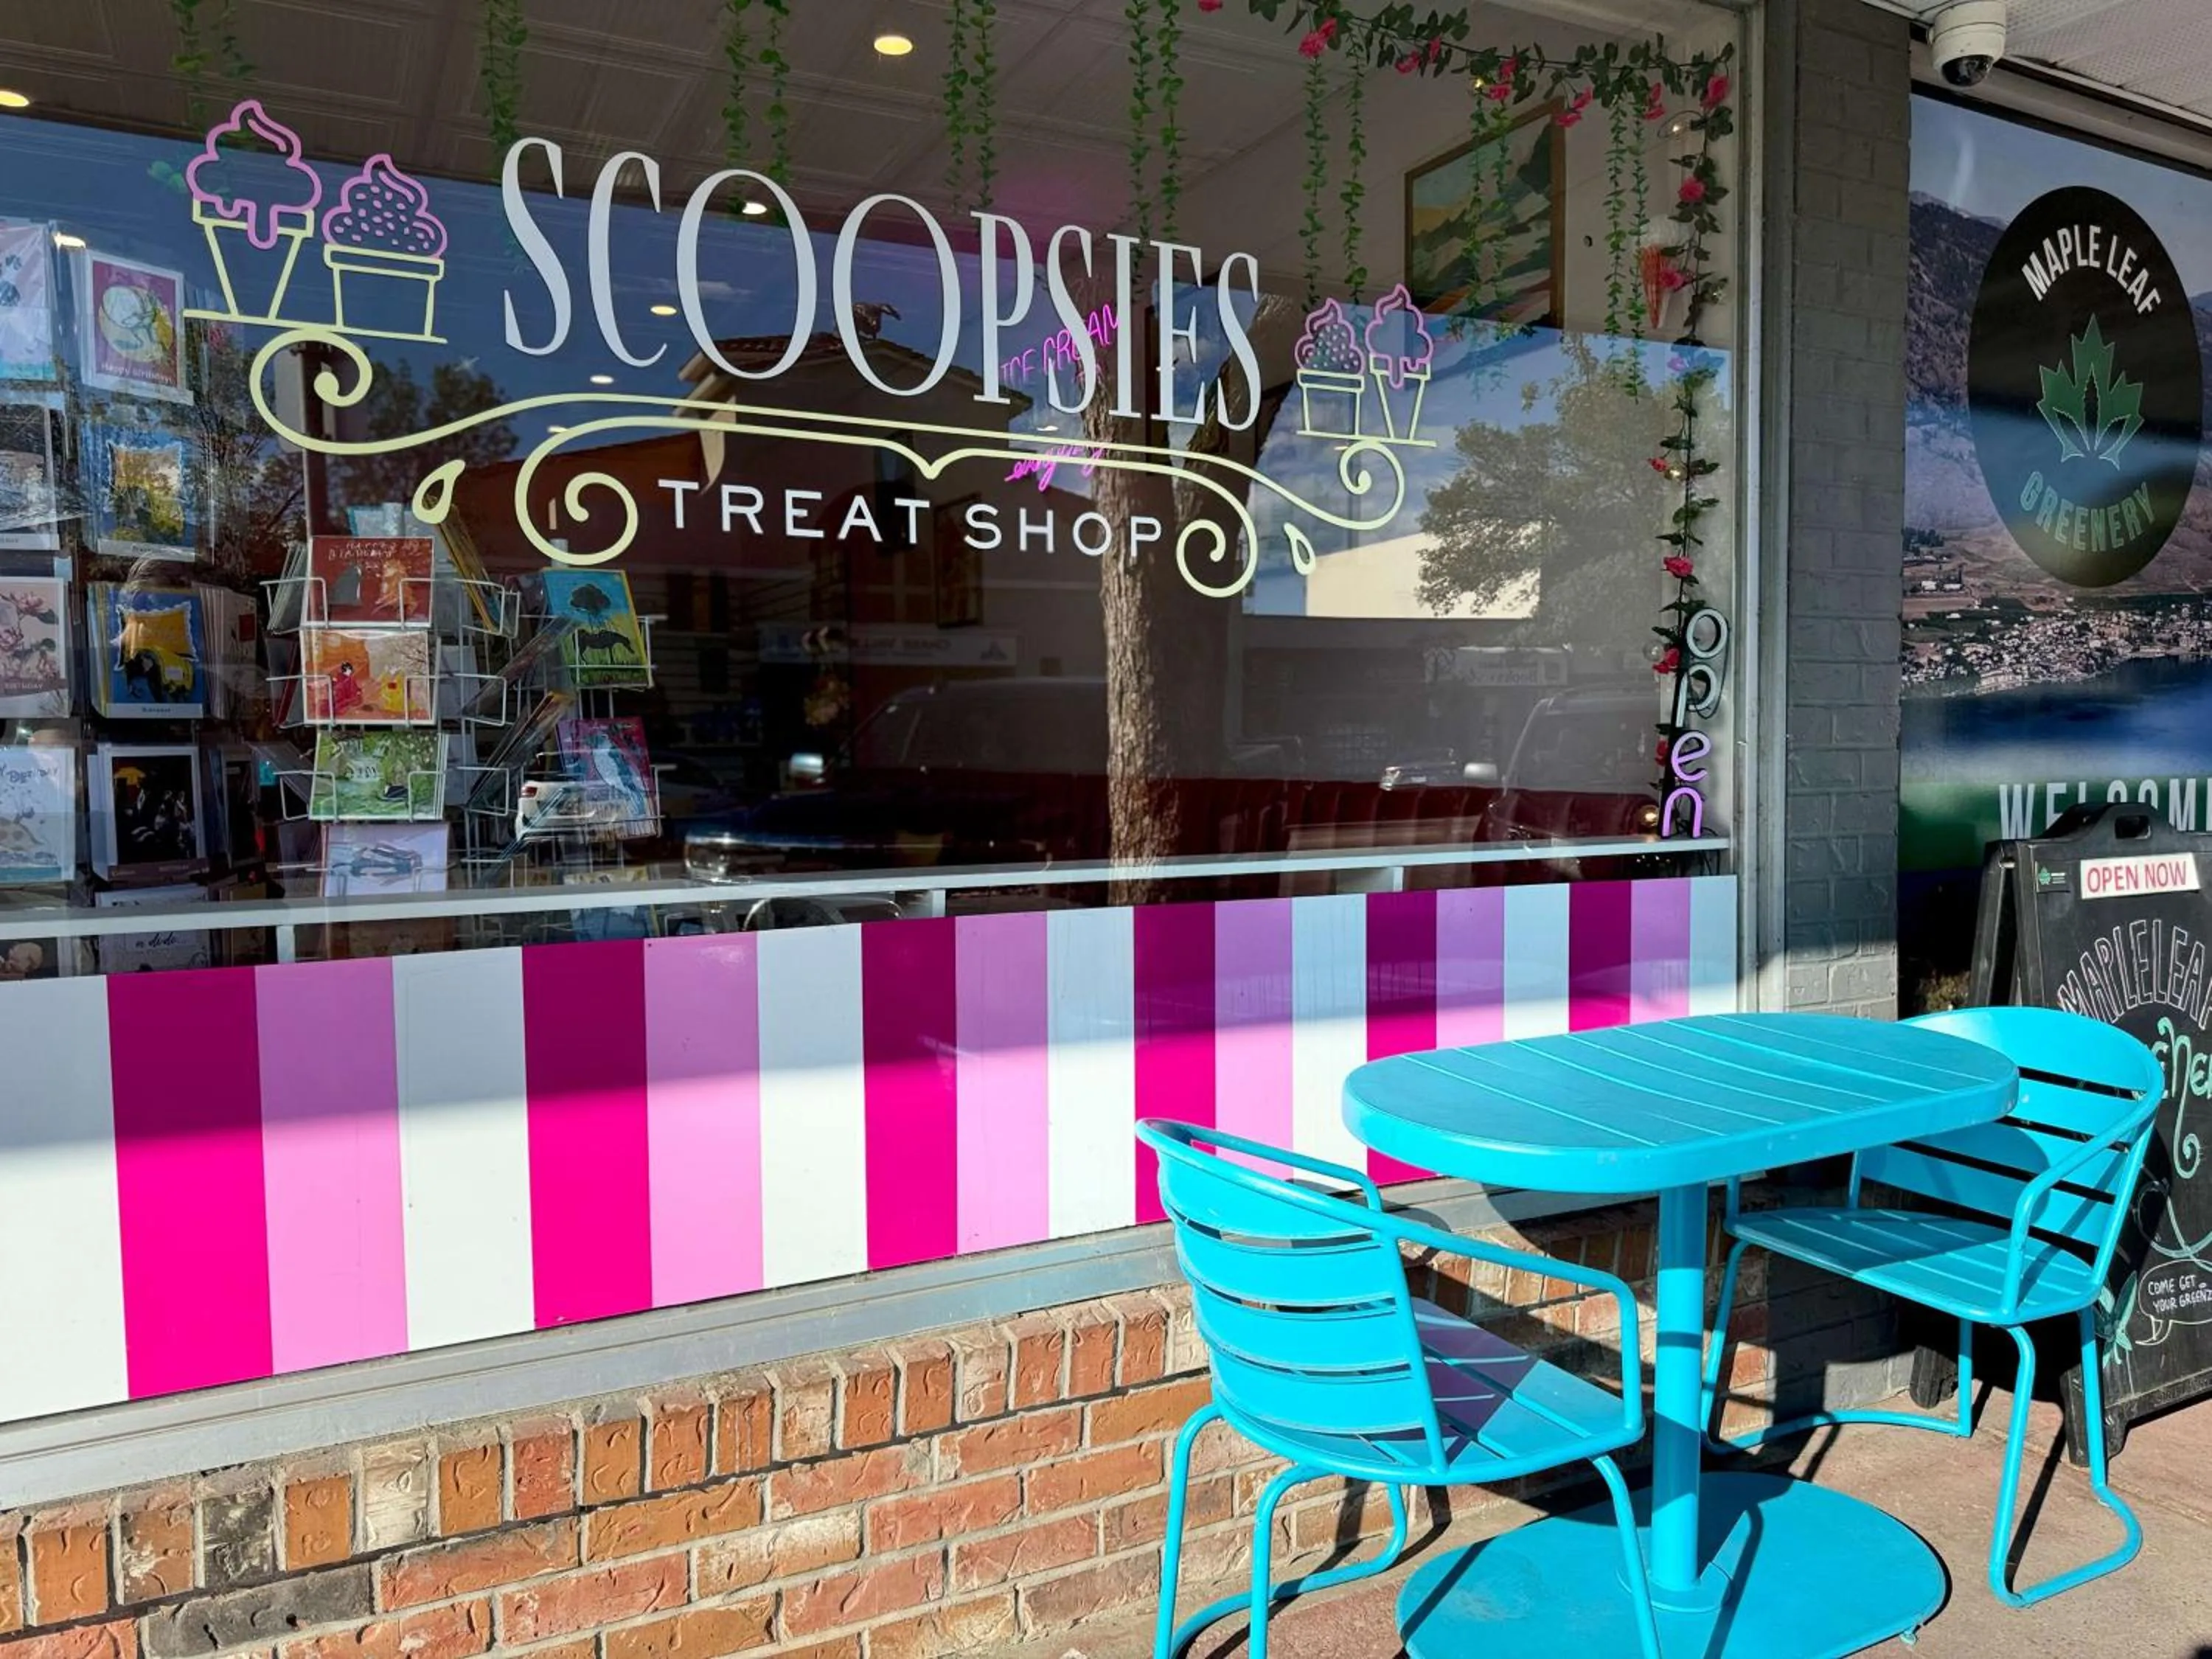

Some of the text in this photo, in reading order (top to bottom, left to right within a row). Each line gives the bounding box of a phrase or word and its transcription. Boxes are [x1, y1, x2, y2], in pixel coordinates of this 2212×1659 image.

[502, 137, 1262, 431] SCOOPSIES
[2022, 224, 2161, 314] MAPLE LEAF
[658, 479, 1162, 557] TREAT SHOP
[2020, 471, 2155, 552] GREENERY
[1662, 608, 1728, 838] open
[2087, 860, 2187, 893] OPEN NOW
[2148, 1274, 2197, 1295] COME GET
[2153, 1297, 2178, 1312] YOUR
